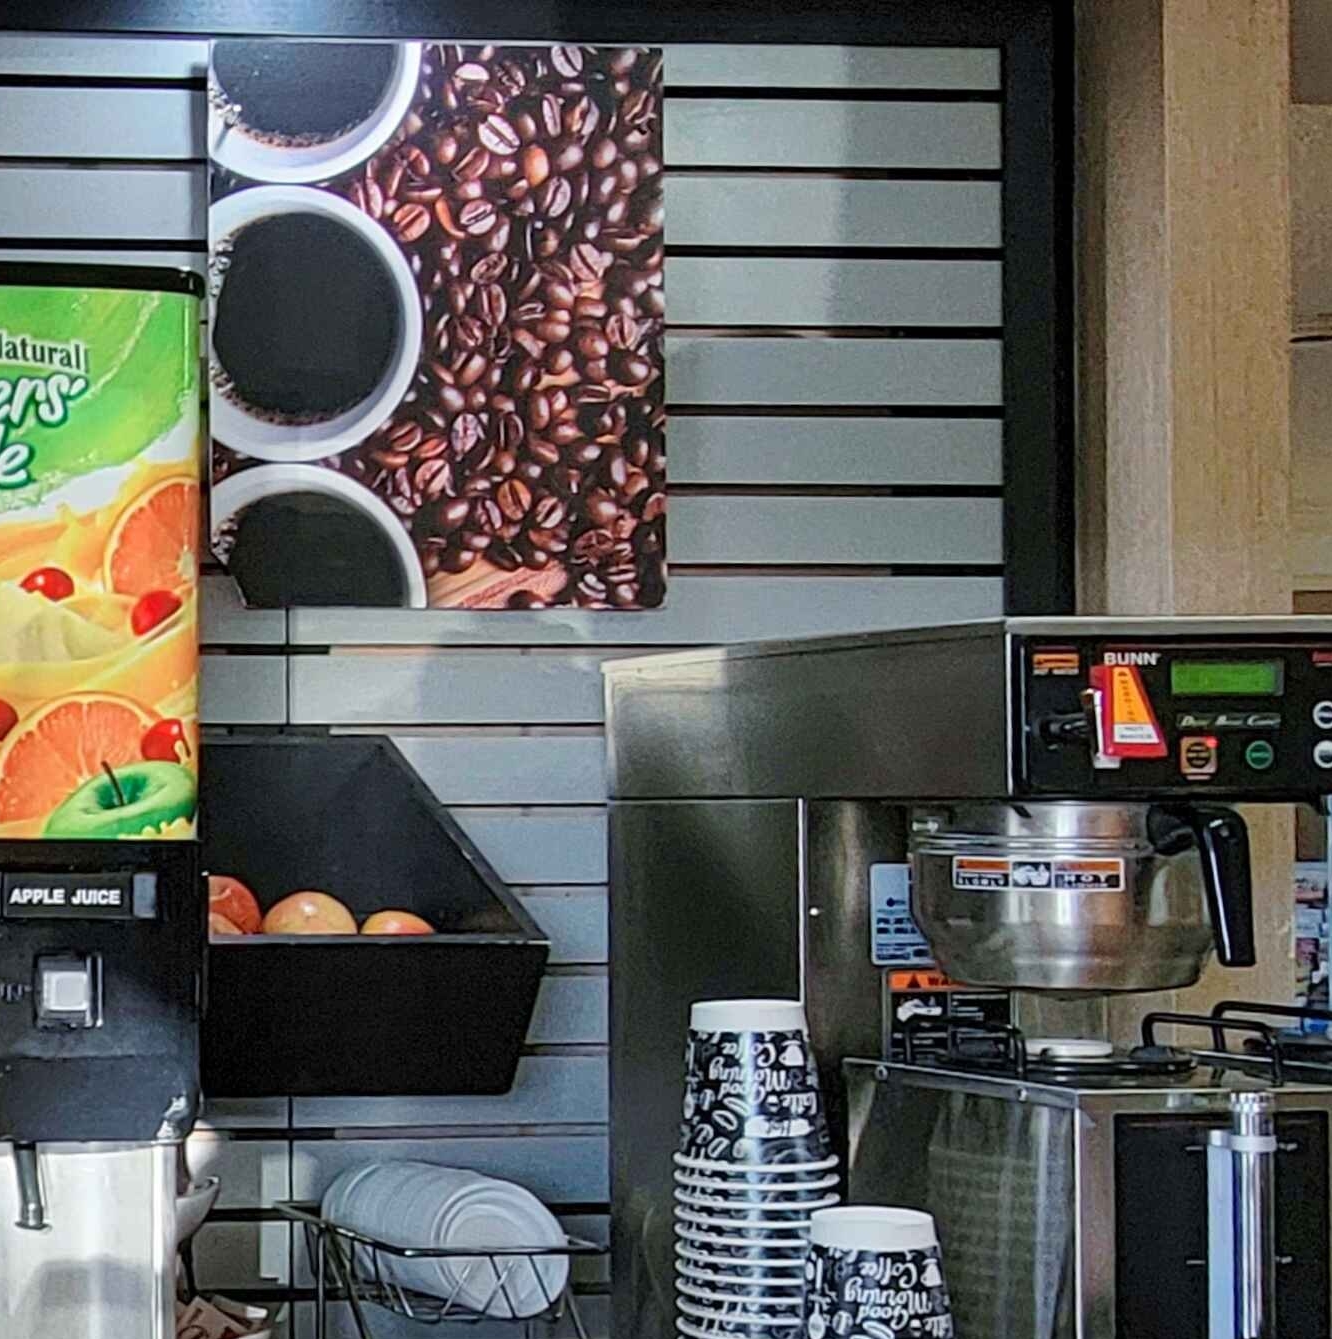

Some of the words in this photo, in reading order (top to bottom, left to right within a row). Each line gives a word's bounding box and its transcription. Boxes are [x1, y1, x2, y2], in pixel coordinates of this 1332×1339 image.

[1104, 652, 1158, 665] BUNN
[9, 887, 66, 905] APPLE
[70, 889, 121, 905] JUICE
[859, 1257, 917, 1287] Coffee
[844, 1276, 932, 1316] Morning
[855, 1304, 908, 1330] Good
